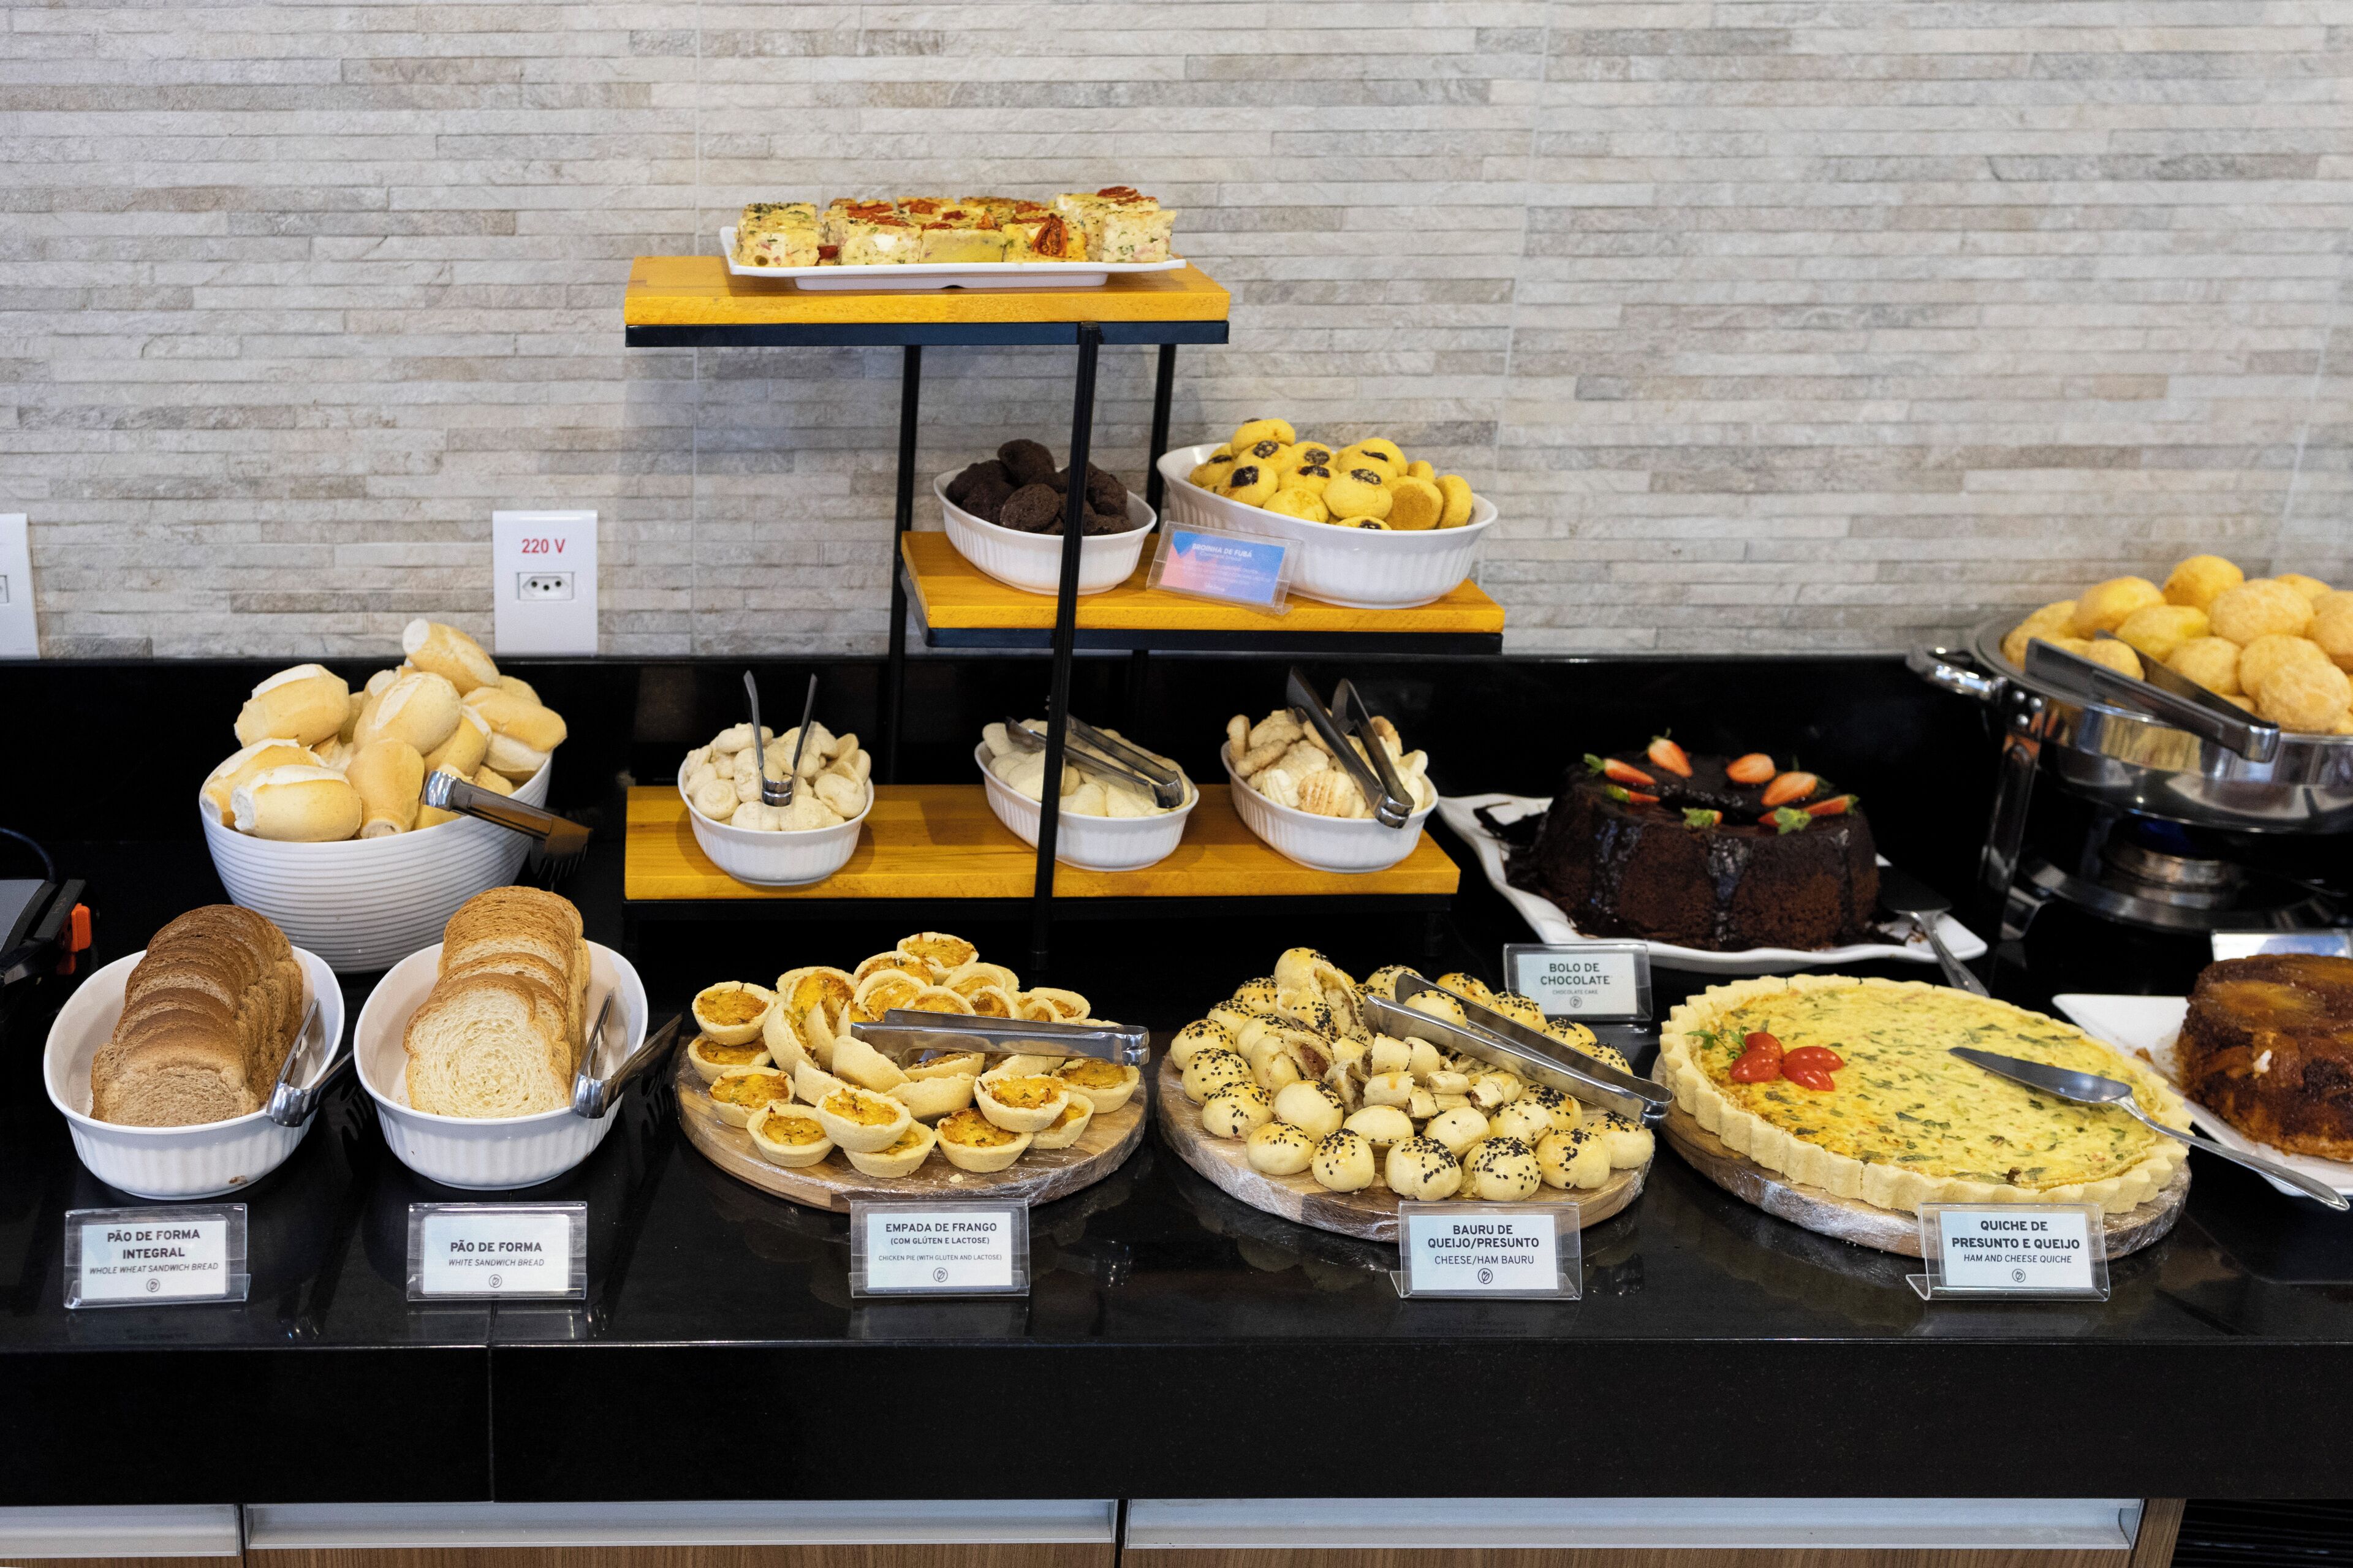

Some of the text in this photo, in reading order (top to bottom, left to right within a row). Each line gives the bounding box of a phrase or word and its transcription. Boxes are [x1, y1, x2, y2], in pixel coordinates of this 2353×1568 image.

[521, 539, 566, 553] 220 V
[1192, 543, 1222, 553] BROINHA
[1550, 963, 1600, 972] BOLO DE
[1540, 975, 1610, 985] CHOCOLATE
[886, 1224, 931, 1232] EMPADA
[953, 1223, 997, 1232] FRANGO
[1453, 1225, 1513, 1235] BAURU DE
[1980, 1221, 2048, 1231] QUICHE DE
[107, 1229, 200, 1242] PÃO DE FORMA
[450, 1240, 542, 1252] PÃO DE FORMA
[1428, 1238, 1539, 1249] QUEIJO/PRESUNTO
[1952, 1238, 2080, 1249] PRESUNTO E QUEIJO
[123, 1248, 185, 1259] INTEGRAL
[1434, 1256, 1498, 1265] CHEESE/HAM
[148, 1264, 189, 1273] SANDWICH
